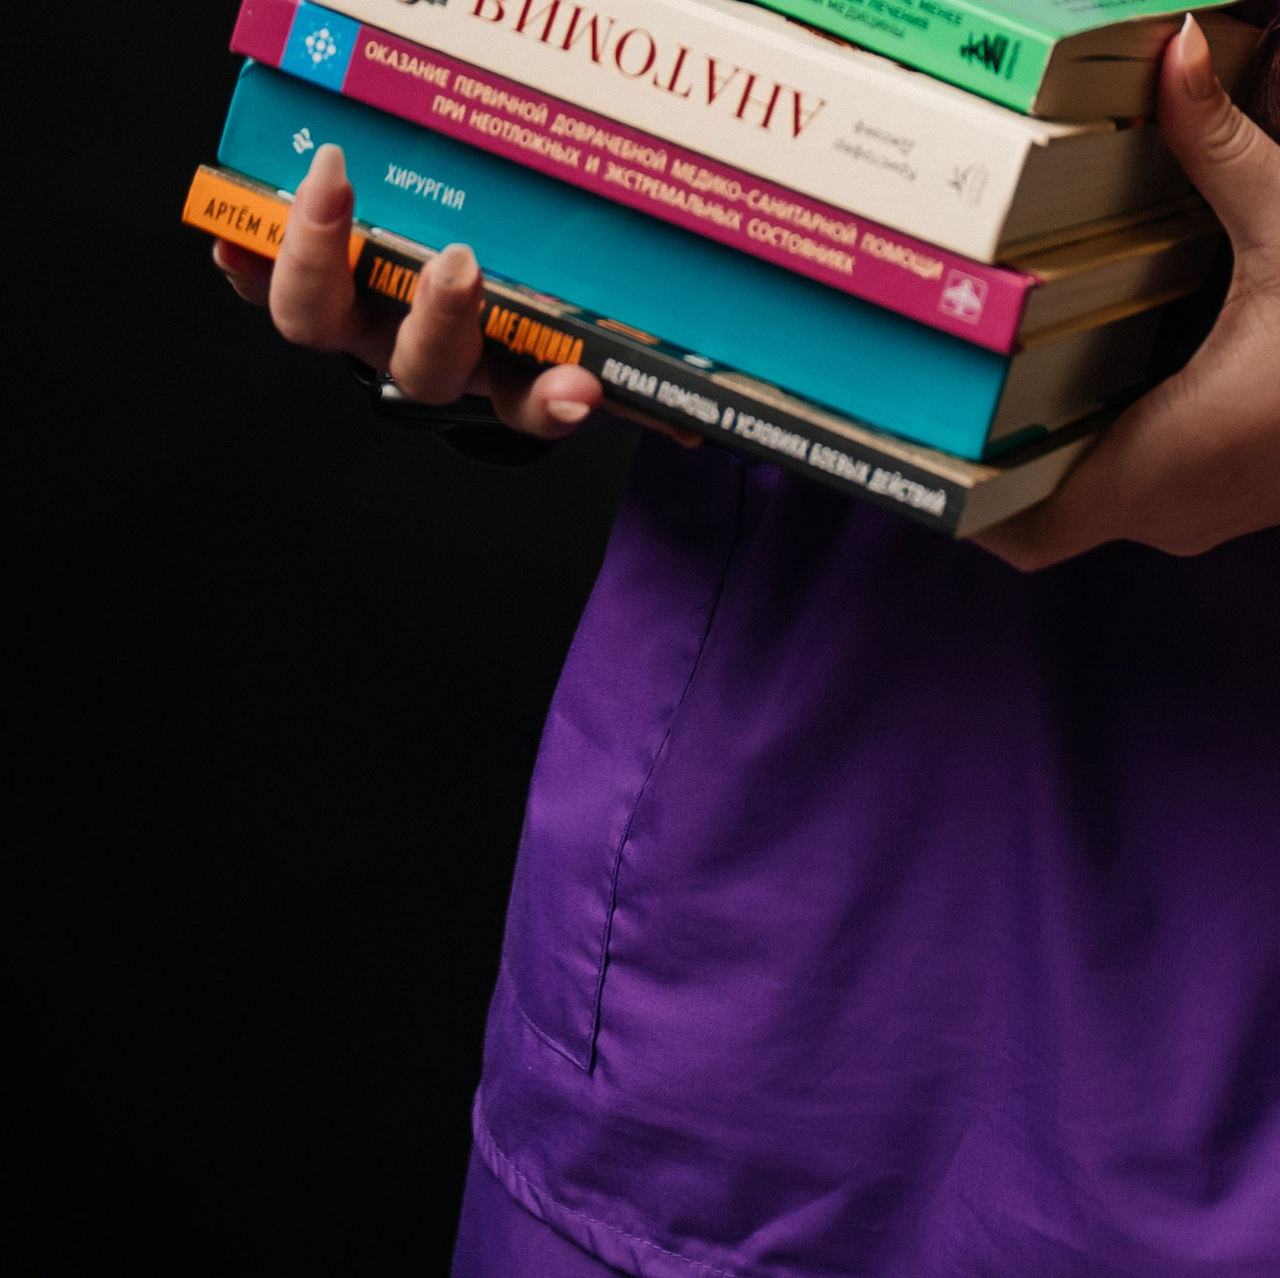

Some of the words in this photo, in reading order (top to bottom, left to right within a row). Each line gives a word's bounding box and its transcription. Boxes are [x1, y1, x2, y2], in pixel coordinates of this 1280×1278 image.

[827, 0, 907, 39] МЕДИЦИНЫ
[364, 41, 451, 89] ОКАЗАНИЕ
[453, 75, 549, 127] ПЕРВИЧНОЙ
[551, 113, 668, 174] ДОВРАЧЕБНОЙ
[670, 157, 858, 245] МЕДИКО-САНИТАРНОЙ
[860, 231, 944, 281] ПОМОЩИ
[384, 162, 466, 211] ХИРУРГИЯ
[431, 94, 465, 124] ПРИ
[469, 110, 582, 167] НЕОТЛОЖНЫХ
[584, 153, 600, 176] И
[603, 160, 743, 231] ЭКСТРЕМАЛЬНЫХ
[747, 218, 857, 276] СОСТОЯНИЯХ
[204, 197, 262, 233] АРТЁМ
[485, 305, 584, 365] МЕДИЦИНА
[601, 357, 657, 399] ПЕРВАЯ
[655, 380, 720, 425] ПОМОЩЬ
[720, 407, 735, 431] В
[735, 412, 810, 461] УСЛОВИЯХ
[808, 441, 872, 486] БОЕВЫХ
[867, 467, 947, 518] ДЕЙСТВИЙ
